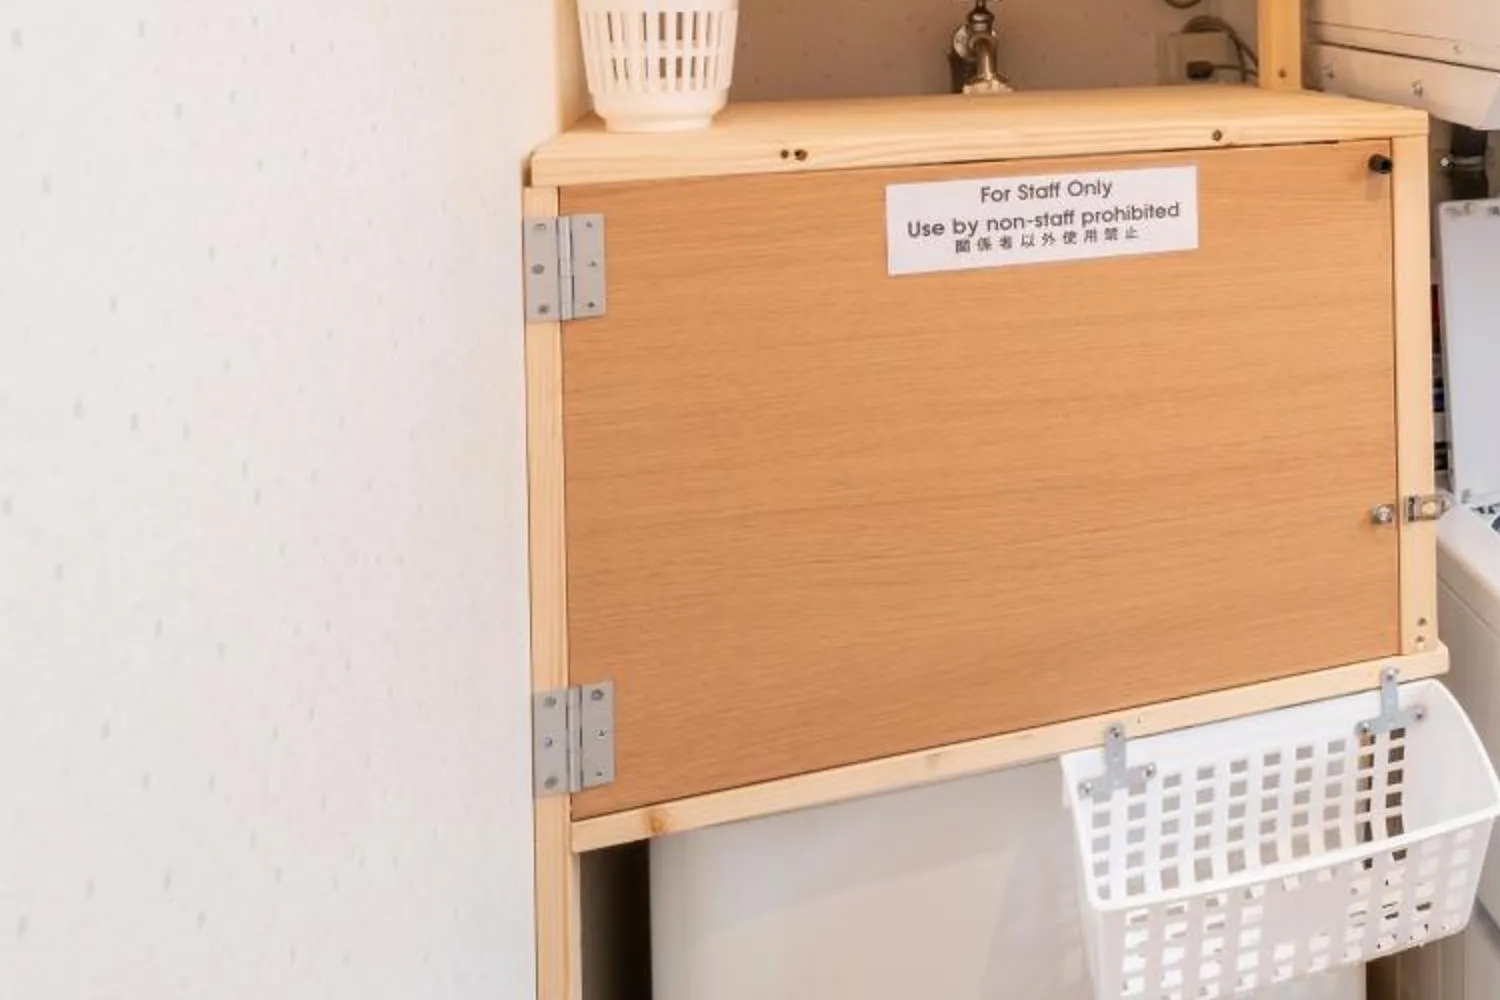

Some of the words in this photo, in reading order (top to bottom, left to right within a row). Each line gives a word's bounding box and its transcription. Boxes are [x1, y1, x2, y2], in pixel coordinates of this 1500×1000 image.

[980, 185, 1011, 203] For
[1018, 181, 1060, 201] Staff
[1067, 178, 1113, 199] Only
[907, 221, 945, 239] Use
[953, 217, 978, 238] by
[987, 209, 1075, 232] non-staff
[1082, 202, 1180, 228] prohibited
